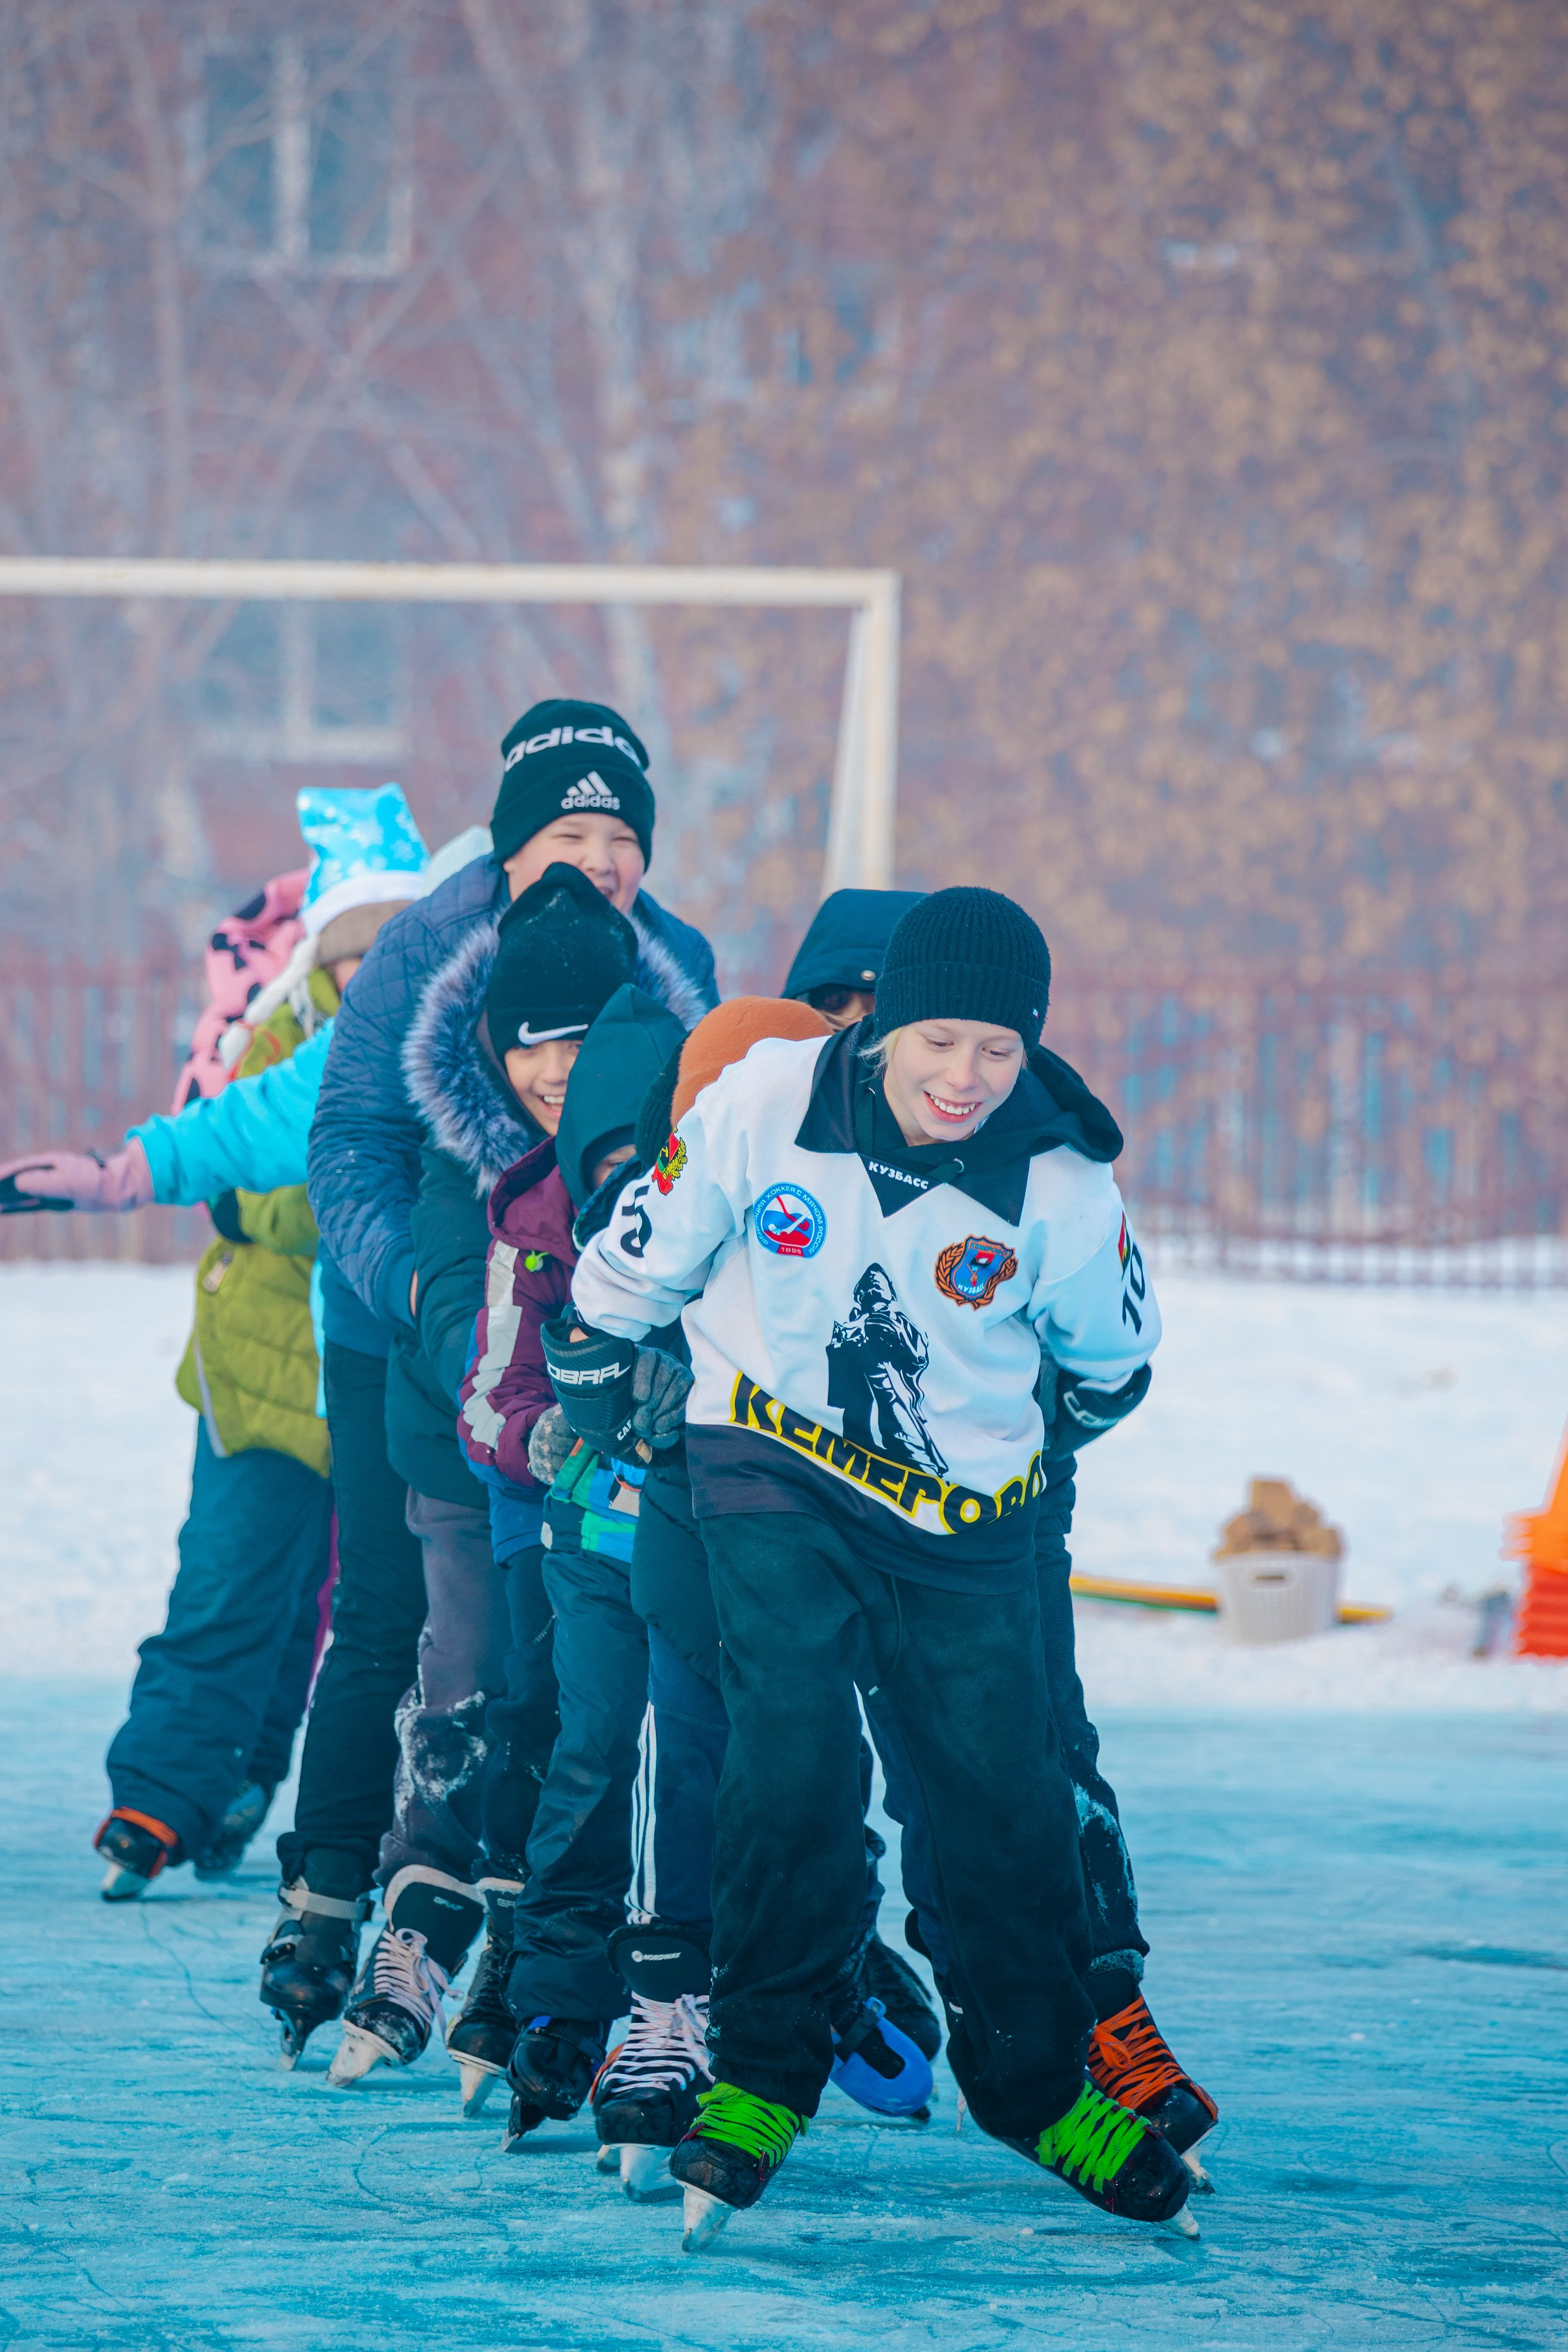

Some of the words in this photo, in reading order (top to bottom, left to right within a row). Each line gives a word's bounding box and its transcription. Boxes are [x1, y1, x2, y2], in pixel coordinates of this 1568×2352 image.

[504, 726, 643, 773] adida
[561, 794, 620, 810] adidas
[868, 1161, 929, 1190] КУЗБАСС
[766, 1186, 796, 1200] ХОККЕЯ
[802, 1194, 823, 1224] МЯЧОМ
[808, 1226, 823, 1254] РОССИИ
[958, 1282, 985, 1294] КУЗБАСС
[547, 1362, 631, 1385] OBRA
